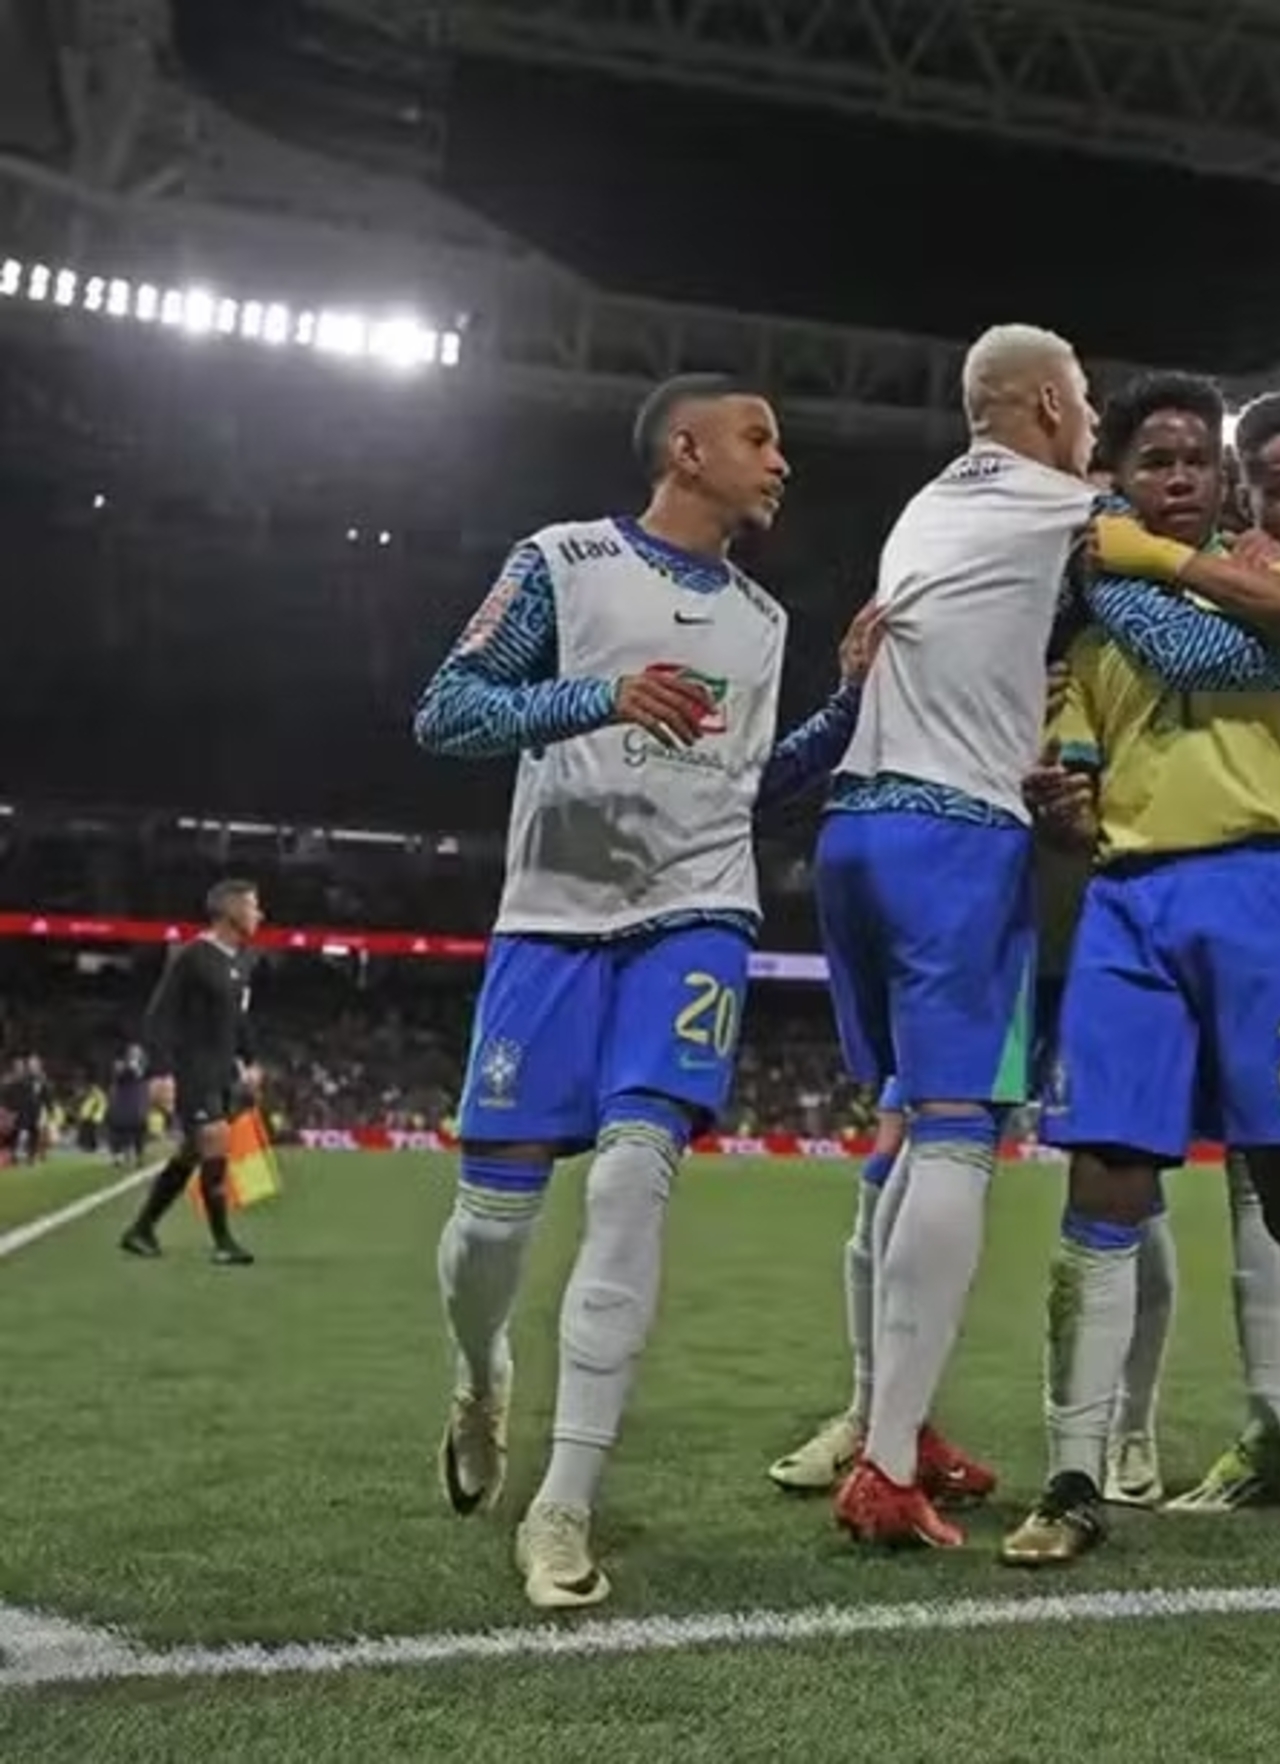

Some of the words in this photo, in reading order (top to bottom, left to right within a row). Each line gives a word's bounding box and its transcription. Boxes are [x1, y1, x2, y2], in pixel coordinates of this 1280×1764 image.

[674, 972, 736, 1058] 20
[301, 1129, 358, 1150] TCL
[388, 1130, 443, 1151] TCL
[799, 1138, 849, 1157] TCL
